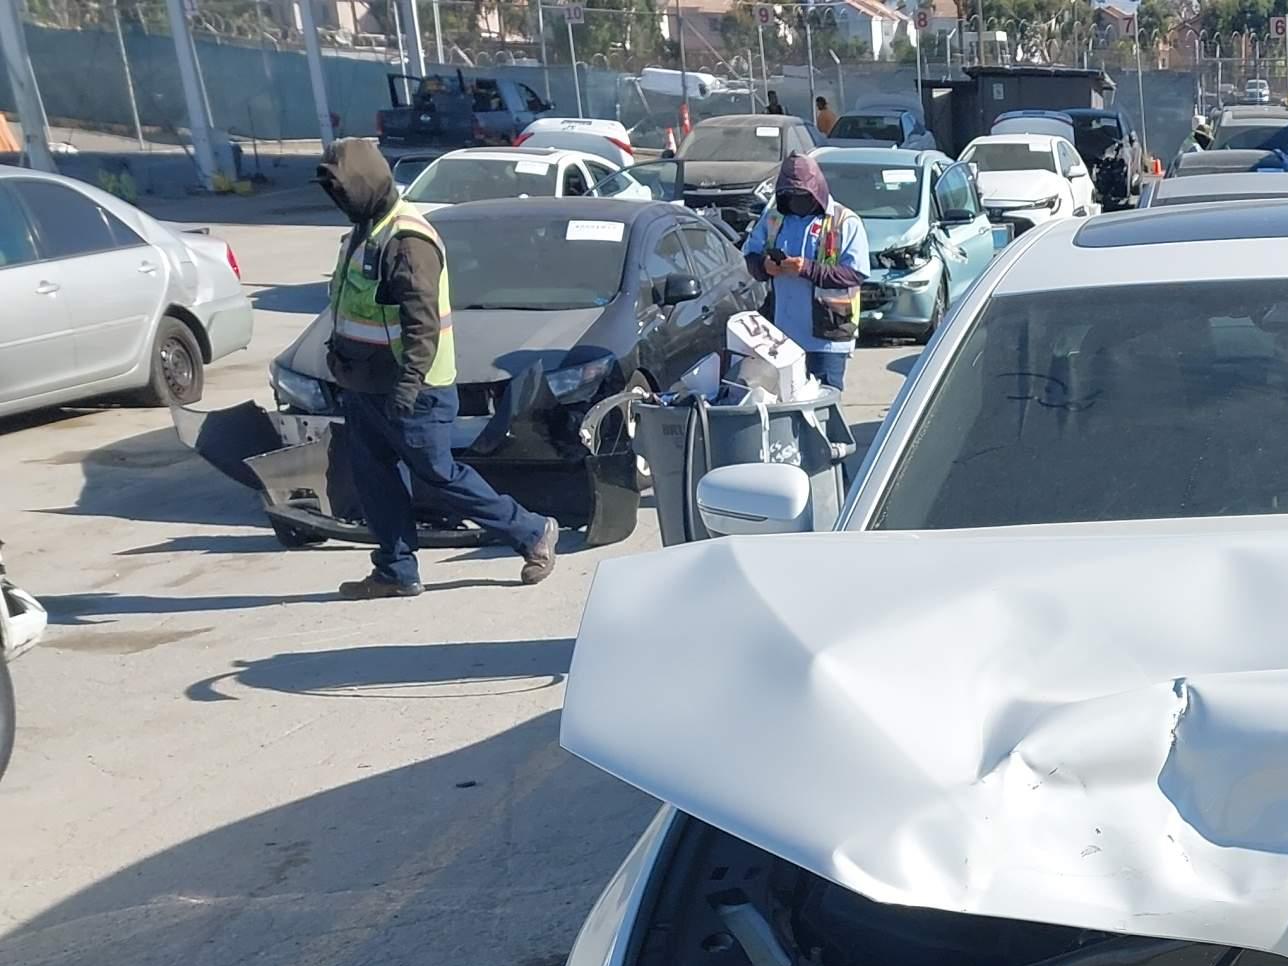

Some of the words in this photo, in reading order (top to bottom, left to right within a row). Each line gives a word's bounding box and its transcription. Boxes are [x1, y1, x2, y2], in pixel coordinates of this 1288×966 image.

[567, 7, 582, 20] 10
[758, 7, 769, 24] 9
[917, 12, 928, 28] 8
[1122, 17, 1133, 33] 7
[1275, 19, 1286, 35] 6
